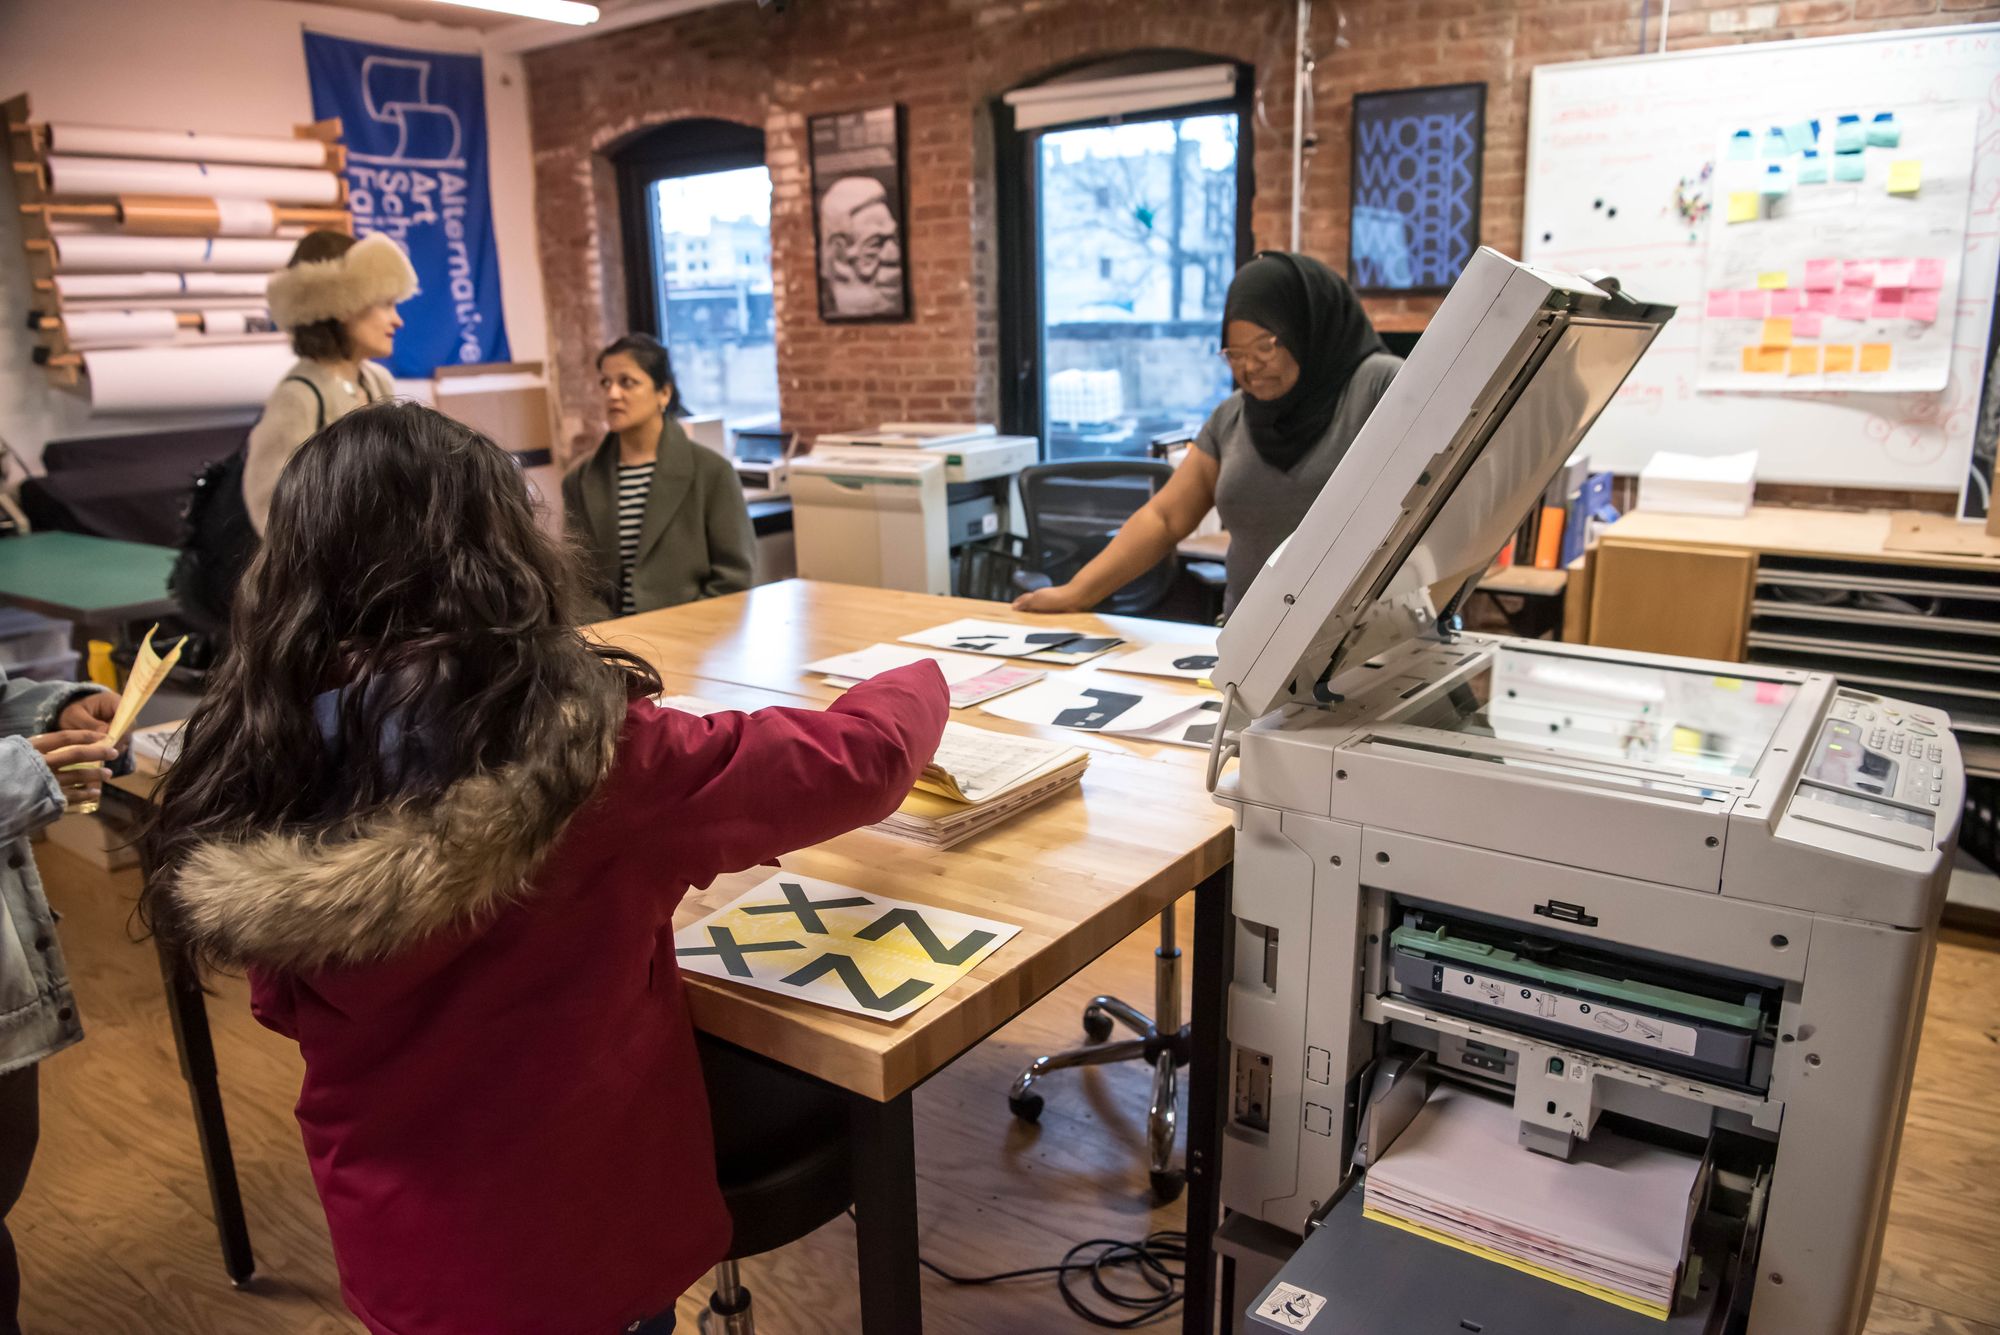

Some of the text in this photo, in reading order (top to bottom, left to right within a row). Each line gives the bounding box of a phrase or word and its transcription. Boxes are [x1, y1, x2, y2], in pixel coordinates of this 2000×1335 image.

[1359, 111, 1475, 154] WORK
[1358, 148, 1474, 189] WORK
[410, 171, 438, 225] Art
[437, 171, 481, 364] Alternative
